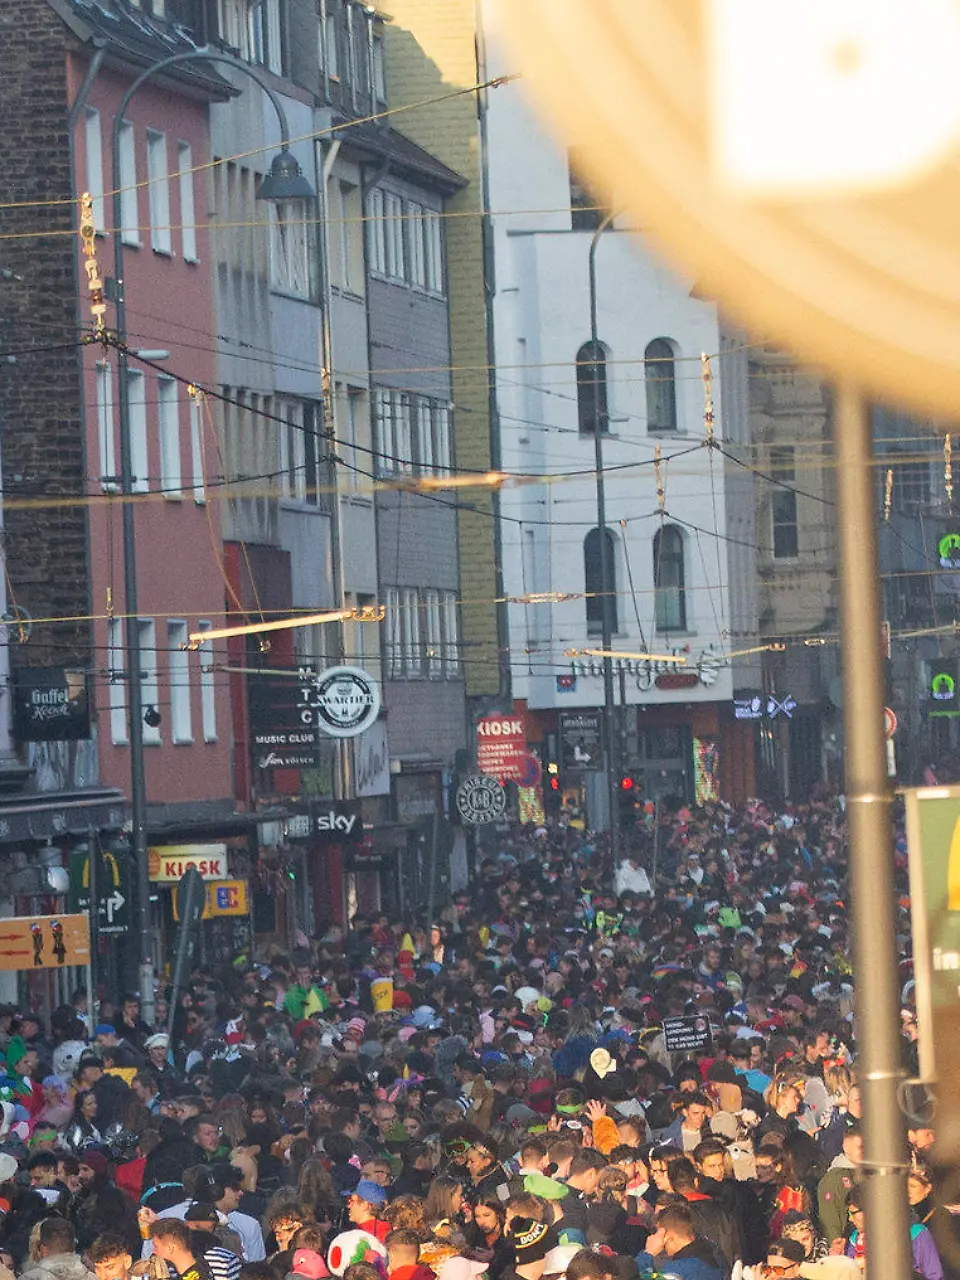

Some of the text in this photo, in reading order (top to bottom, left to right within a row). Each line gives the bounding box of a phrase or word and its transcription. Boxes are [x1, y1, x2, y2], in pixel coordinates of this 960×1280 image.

[255, 733, 315, 744] MUSIC CLUB
[317, 811, 357, 835] sky
[165, 860, 221, 877] KISK
